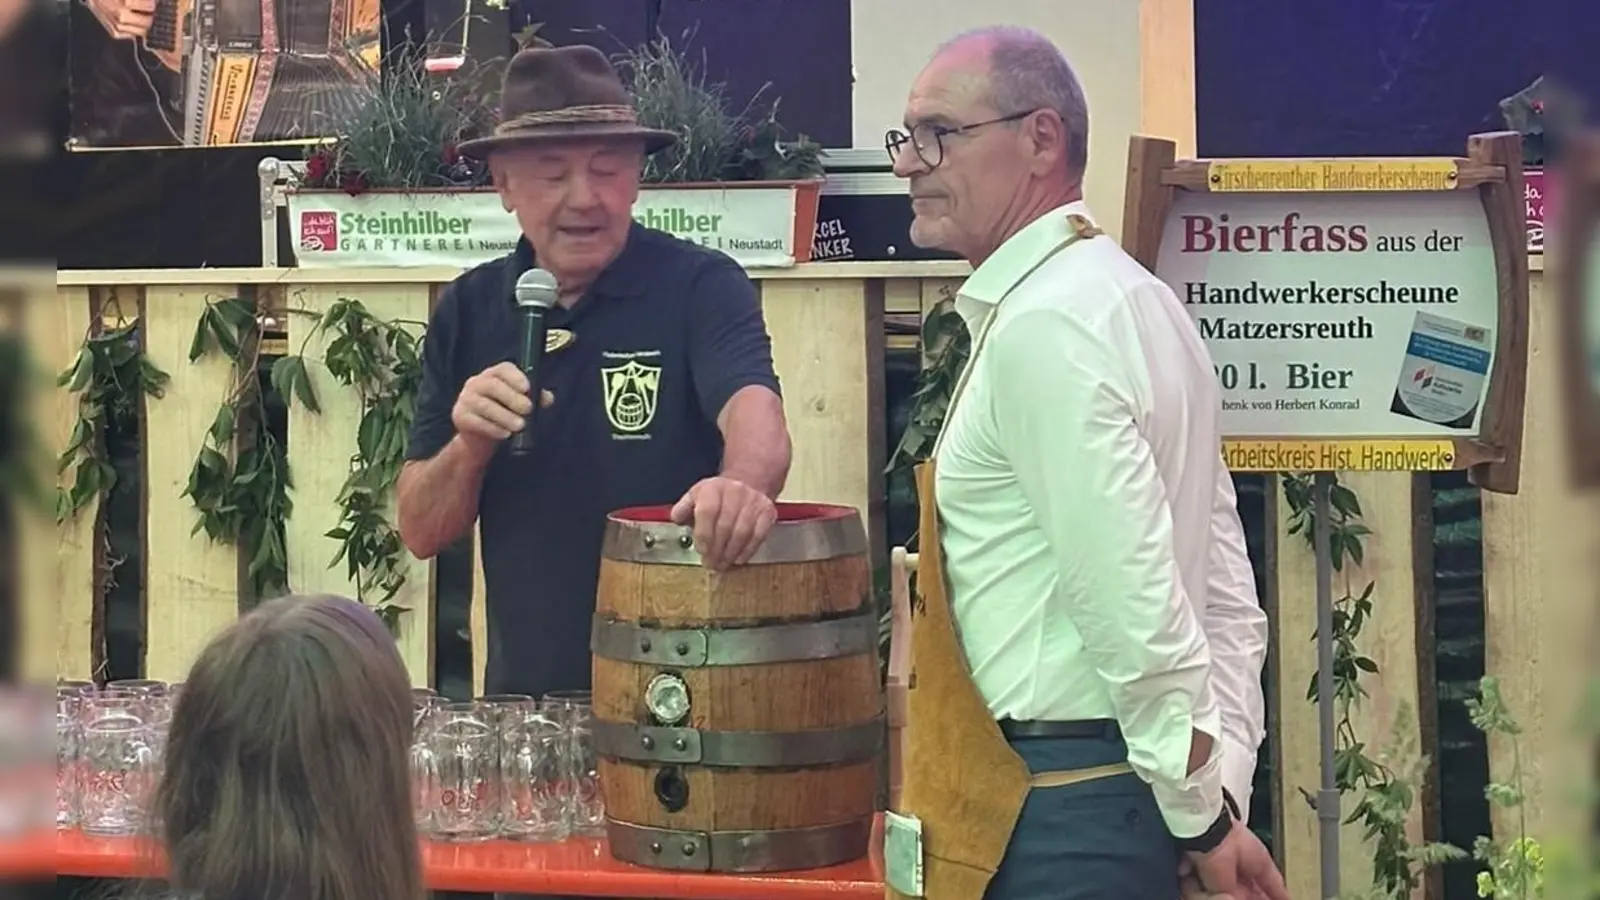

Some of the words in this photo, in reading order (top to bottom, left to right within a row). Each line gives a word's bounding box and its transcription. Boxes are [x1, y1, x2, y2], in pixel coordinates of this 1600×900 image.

[340, 211, 472, 235] Steinhilber
[815, 219, 846, 238] CEL
[1181, 212, 1368, 253] Bierfass
[1376, 234, 1416, 252] aus
[1424, 230, 1463, 252] der
[729, 238, 783, 250] Neustadt
[1185, 281, 1459, 304] Handwerkerscheune
[1199, 316, 1374, 339] Matzersreuth
[1213, 363, 1239, 390] 0
[1286, 362, 1354, 389] Bier
[1252, 401, 1272, 410] von
[1275, 399, 1316, 410] Herbert
[1319, 398, 1360, 410] Konrad
[1320, 443, 1356, 469] Hist.
